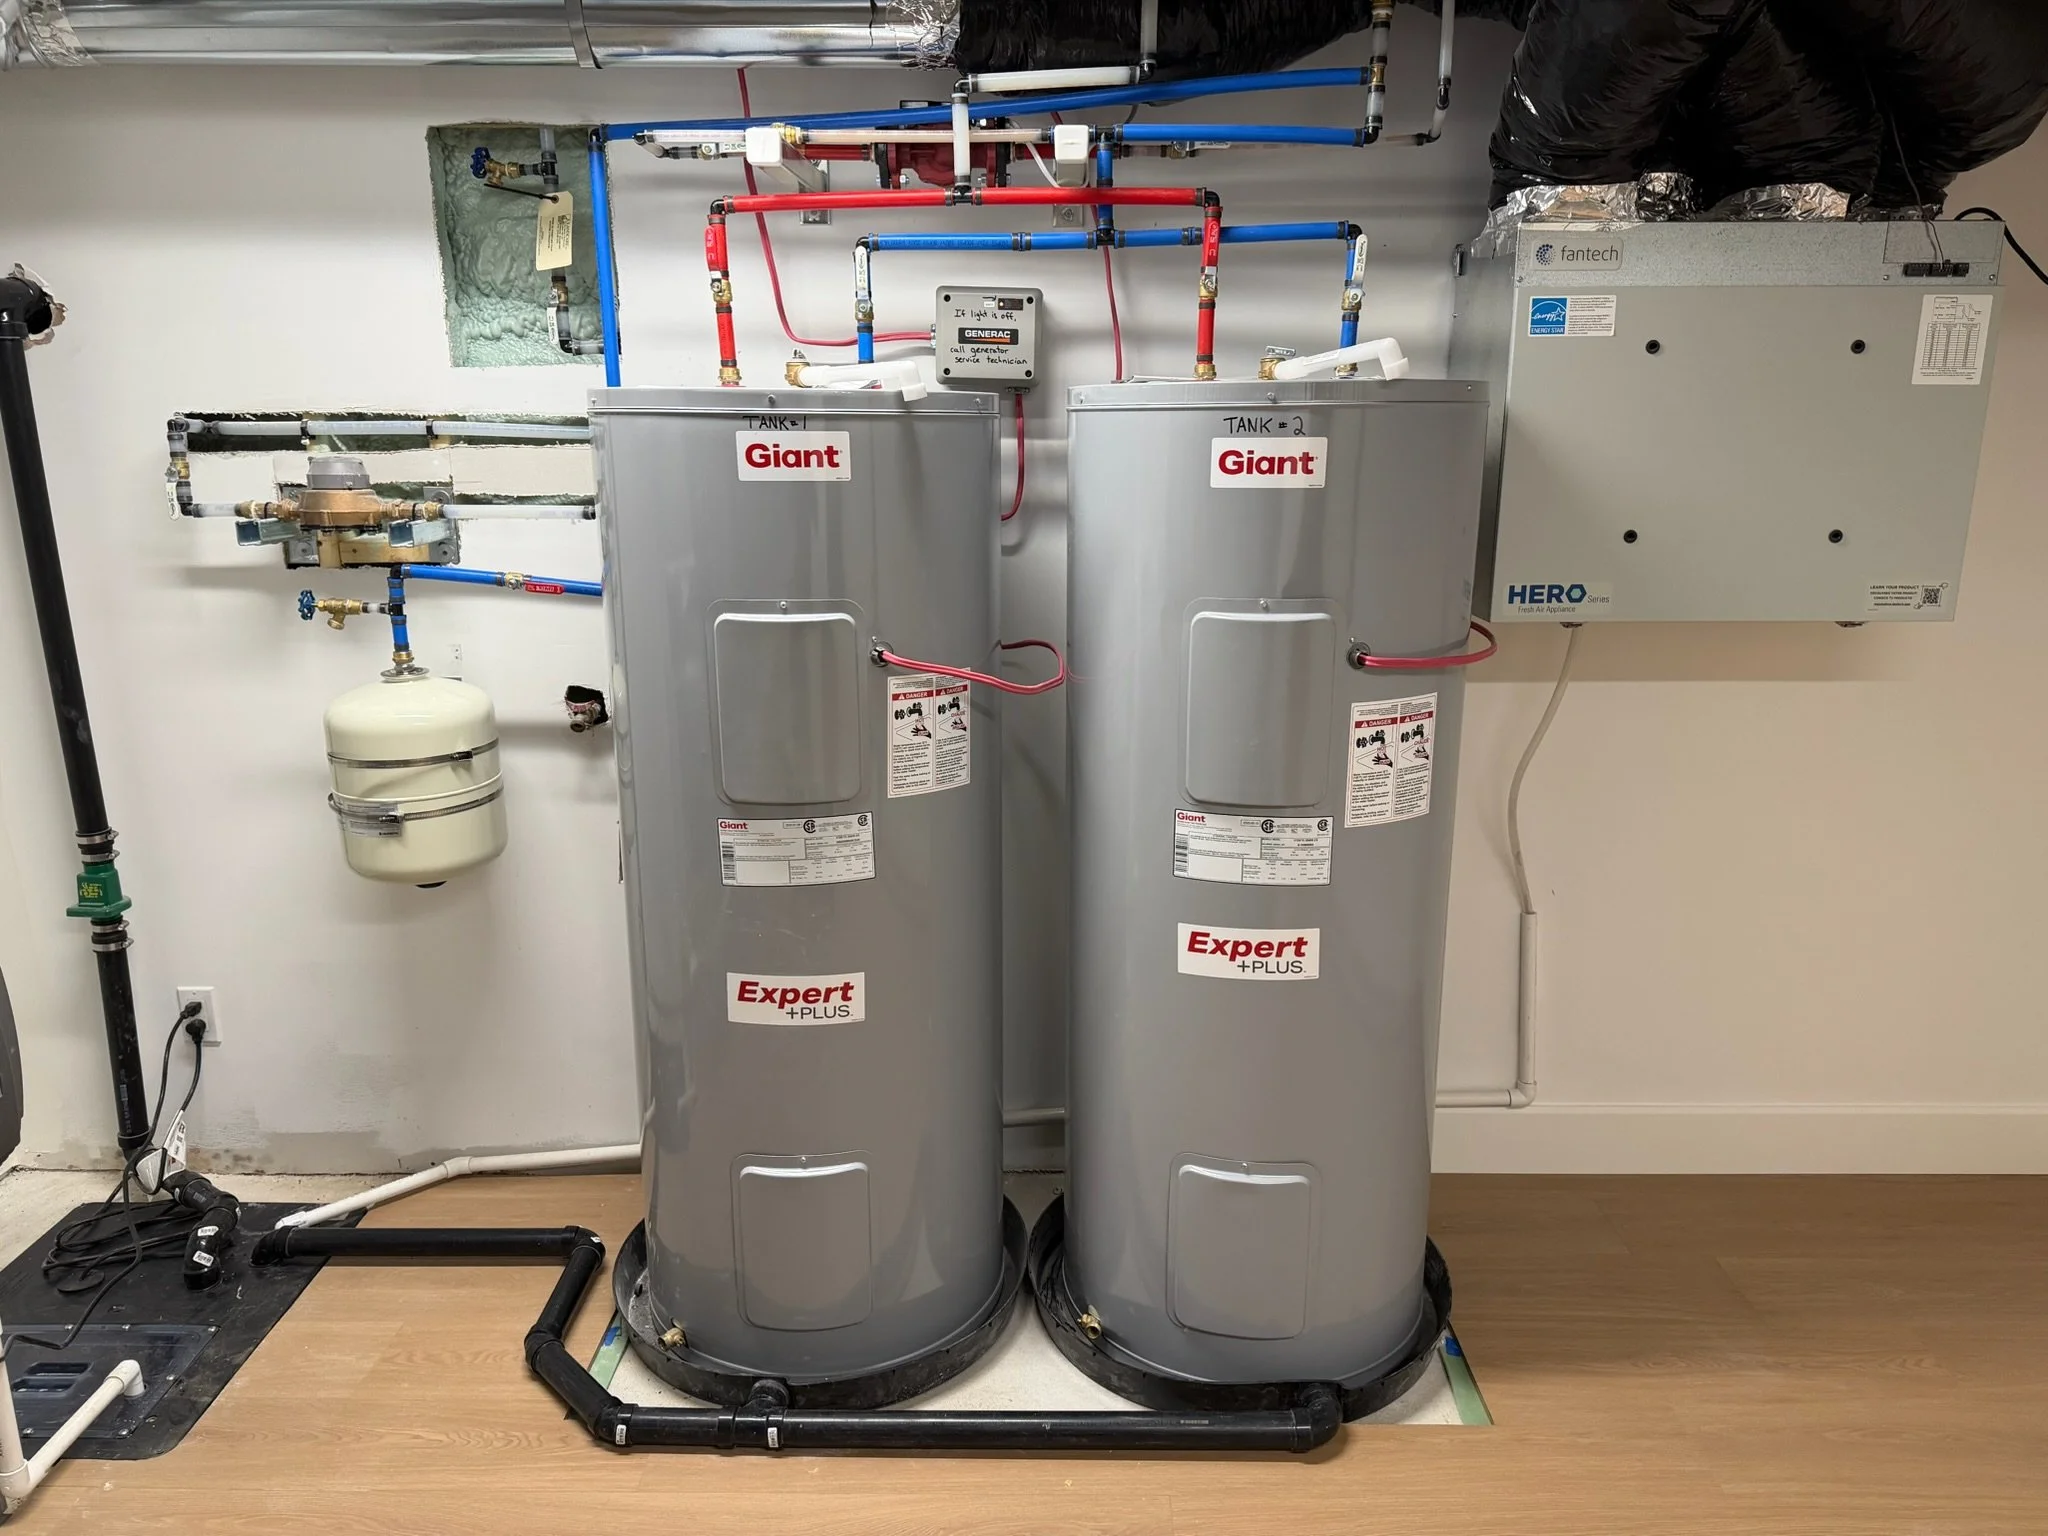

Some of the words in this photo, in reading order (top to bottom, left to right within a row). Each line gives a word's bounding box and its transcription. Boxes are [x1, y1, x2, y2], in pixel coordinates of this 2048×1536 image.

[1561, 245, 1619, 262] fantech
[954, 309, 966, 318] If
[971, 309, 988, 322] light
[992, 311, 998, 320] is
[964, 329, 1011, 338] GENERAC
[950, 345, 966, 354] call
[970, 346, 1009, 358] generator
[954, 356, 981, 364] service
[986, 355, 1028, 365] technician
[742, 415, 789, 431] TANK
[1223, 416, 1273, 434] TANK
[745, 443, 840, 469] Giant
[1218, 449, 1315, 475] Giant
[1508, 584, 1588, 605] HERO
[1587, 594, 1610, 604] Series
[1518, 606, 1535, 614] Fresh
[1546, 605, 1576, 614] Appliance
[905, 691, 928, 700] DANGER
[946, 686, 964, 695] DANGER
[1368, 719, 1392, 727] DANGER
[1410, 712, 1429, 721] DANGER
[1177, 811, 1206, 823] Giant
[719, 820, 748, 830] Giant
[1187, 931, 1309, 962] Expert
[1237, 960, 1304, 974] +PLUS
[737, 980, 855, 1010] Expert
[785, 1005, 851, 1020] +PLUS
